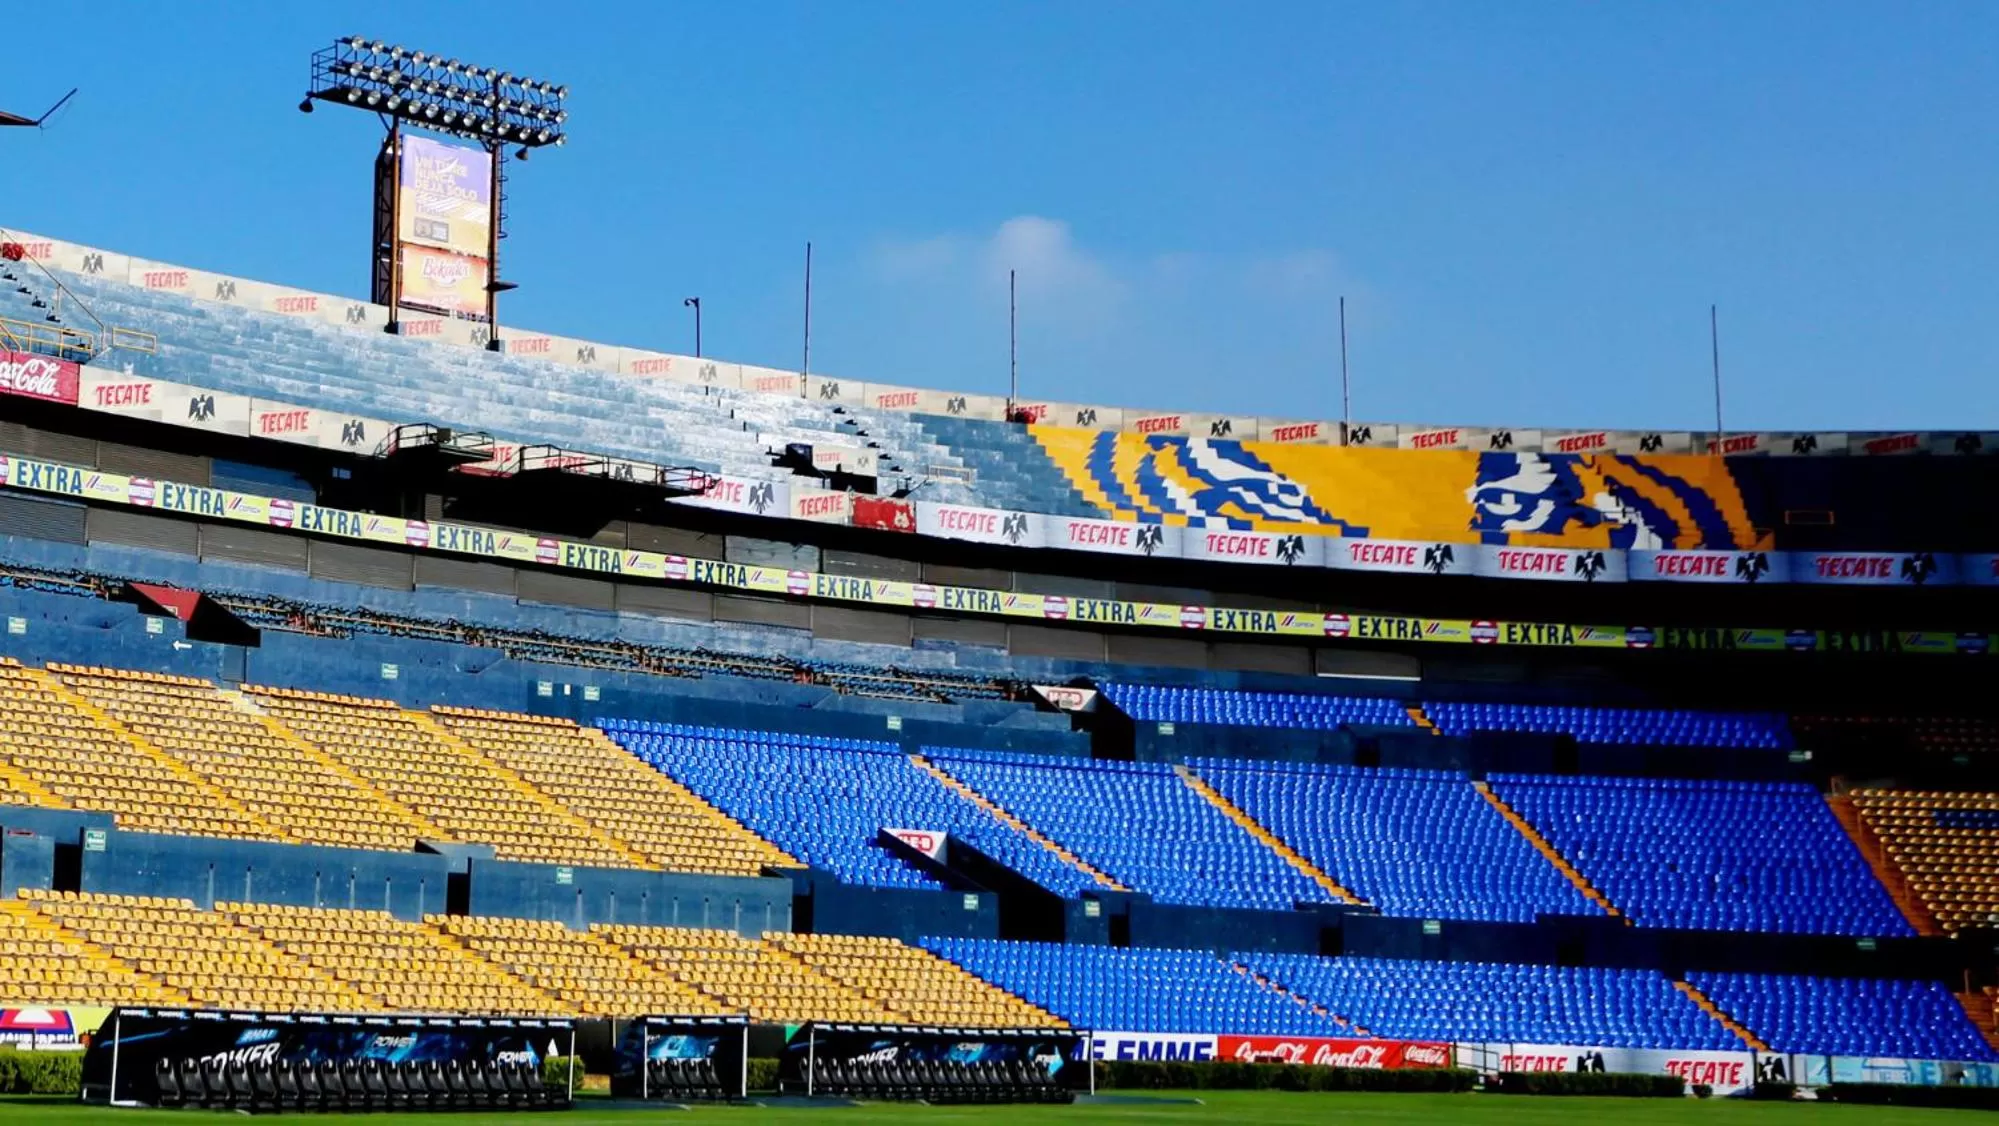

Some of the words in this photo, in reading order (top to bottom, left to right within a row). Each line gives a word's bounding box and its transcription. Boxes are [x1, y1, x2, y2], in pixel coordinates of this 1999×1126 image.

[144, 271, 188, 289] TECATE
[275, 296, 318, 314] TECATE
[402, 319, 443, 336] TECATE
[510, 338, 551, 355] TECATE
[632, 358, 672, 375] TECATE
[96, 384, 153, 406] TECATE
[755, 376, 793, 392] TECATE
[877, 392, 918, 408] TECATE
[261, 411, 310, 434] TECATE
[1136, 416, 1181, 433] TECATE
[1272, 424, 1319, 442] TECATE
[1412, 430, 1459, 448] TECATE
[1557, 433, 1606, 451] TECATE
[17, 461, 82, 494] EXTRA
[163, 484, 225, 516] EXTRA
[799, 495, 844, 517] TECATE
[301, 506, 362, 537] EXTRA
[938, 509, 998, 533] TECATE
[437, 526, 496, 554] EXTRA
[1069, 523, 1130, 546] TECATE
[1206, 534, 1271, 557] TECATE
[566, 545, 622, 573] EXTRA
[1350, 543, 1418, 565] TECATE
[1499, 551, 1568, 573] TECATE
[694, 561, 748, 587] EXTRA
[1655, 556, 1729, 576] TECATE
[1816, 558, 1894, 577] TECATE
[817, 576, 873, 600] EXTRA
[943, 589, 1001, 612] EXTRA
[1076, 600, 1136, 623] EXTRA
[1213, 610, 1277, 632] EXTRA
[1358, 617, 1423, 639] EXTRA
[1507, 624, 1575, 645] EXTRA
[1502, 1055, 1568, 1073] TECATE
[1667, 1060, 1744, 1085] TECATE
